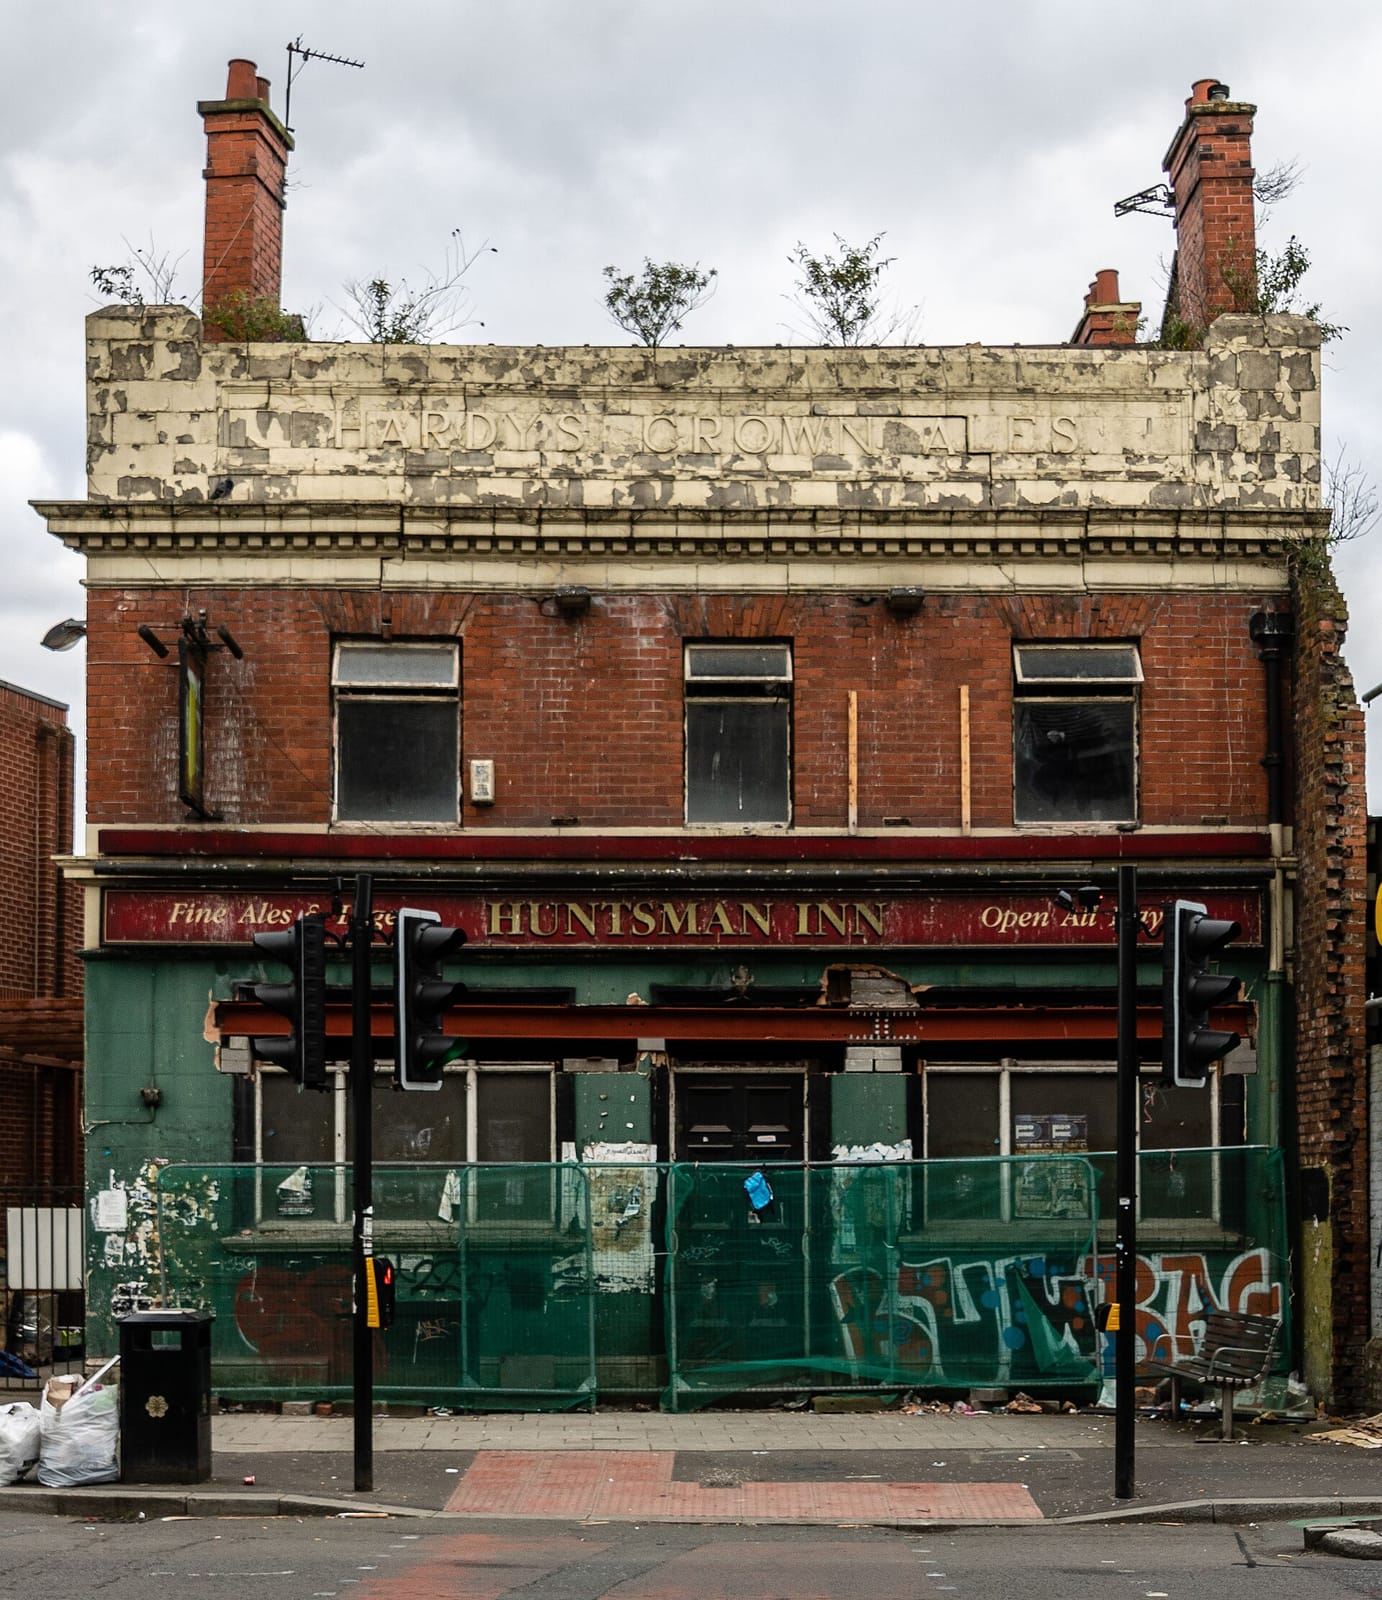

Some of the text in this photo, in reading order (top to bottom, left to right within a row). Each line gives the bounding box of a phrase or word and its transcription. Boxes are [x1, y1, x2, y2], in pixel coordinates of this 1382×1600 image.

[643, 415, 874, 455] CROWN
[170, 902, 226, 925] Fine
[239, 902, 293, 925] Ales
[486, 900, 888, 937] HUNTSMAN INN
[980, 906, 1049, 934] Open
